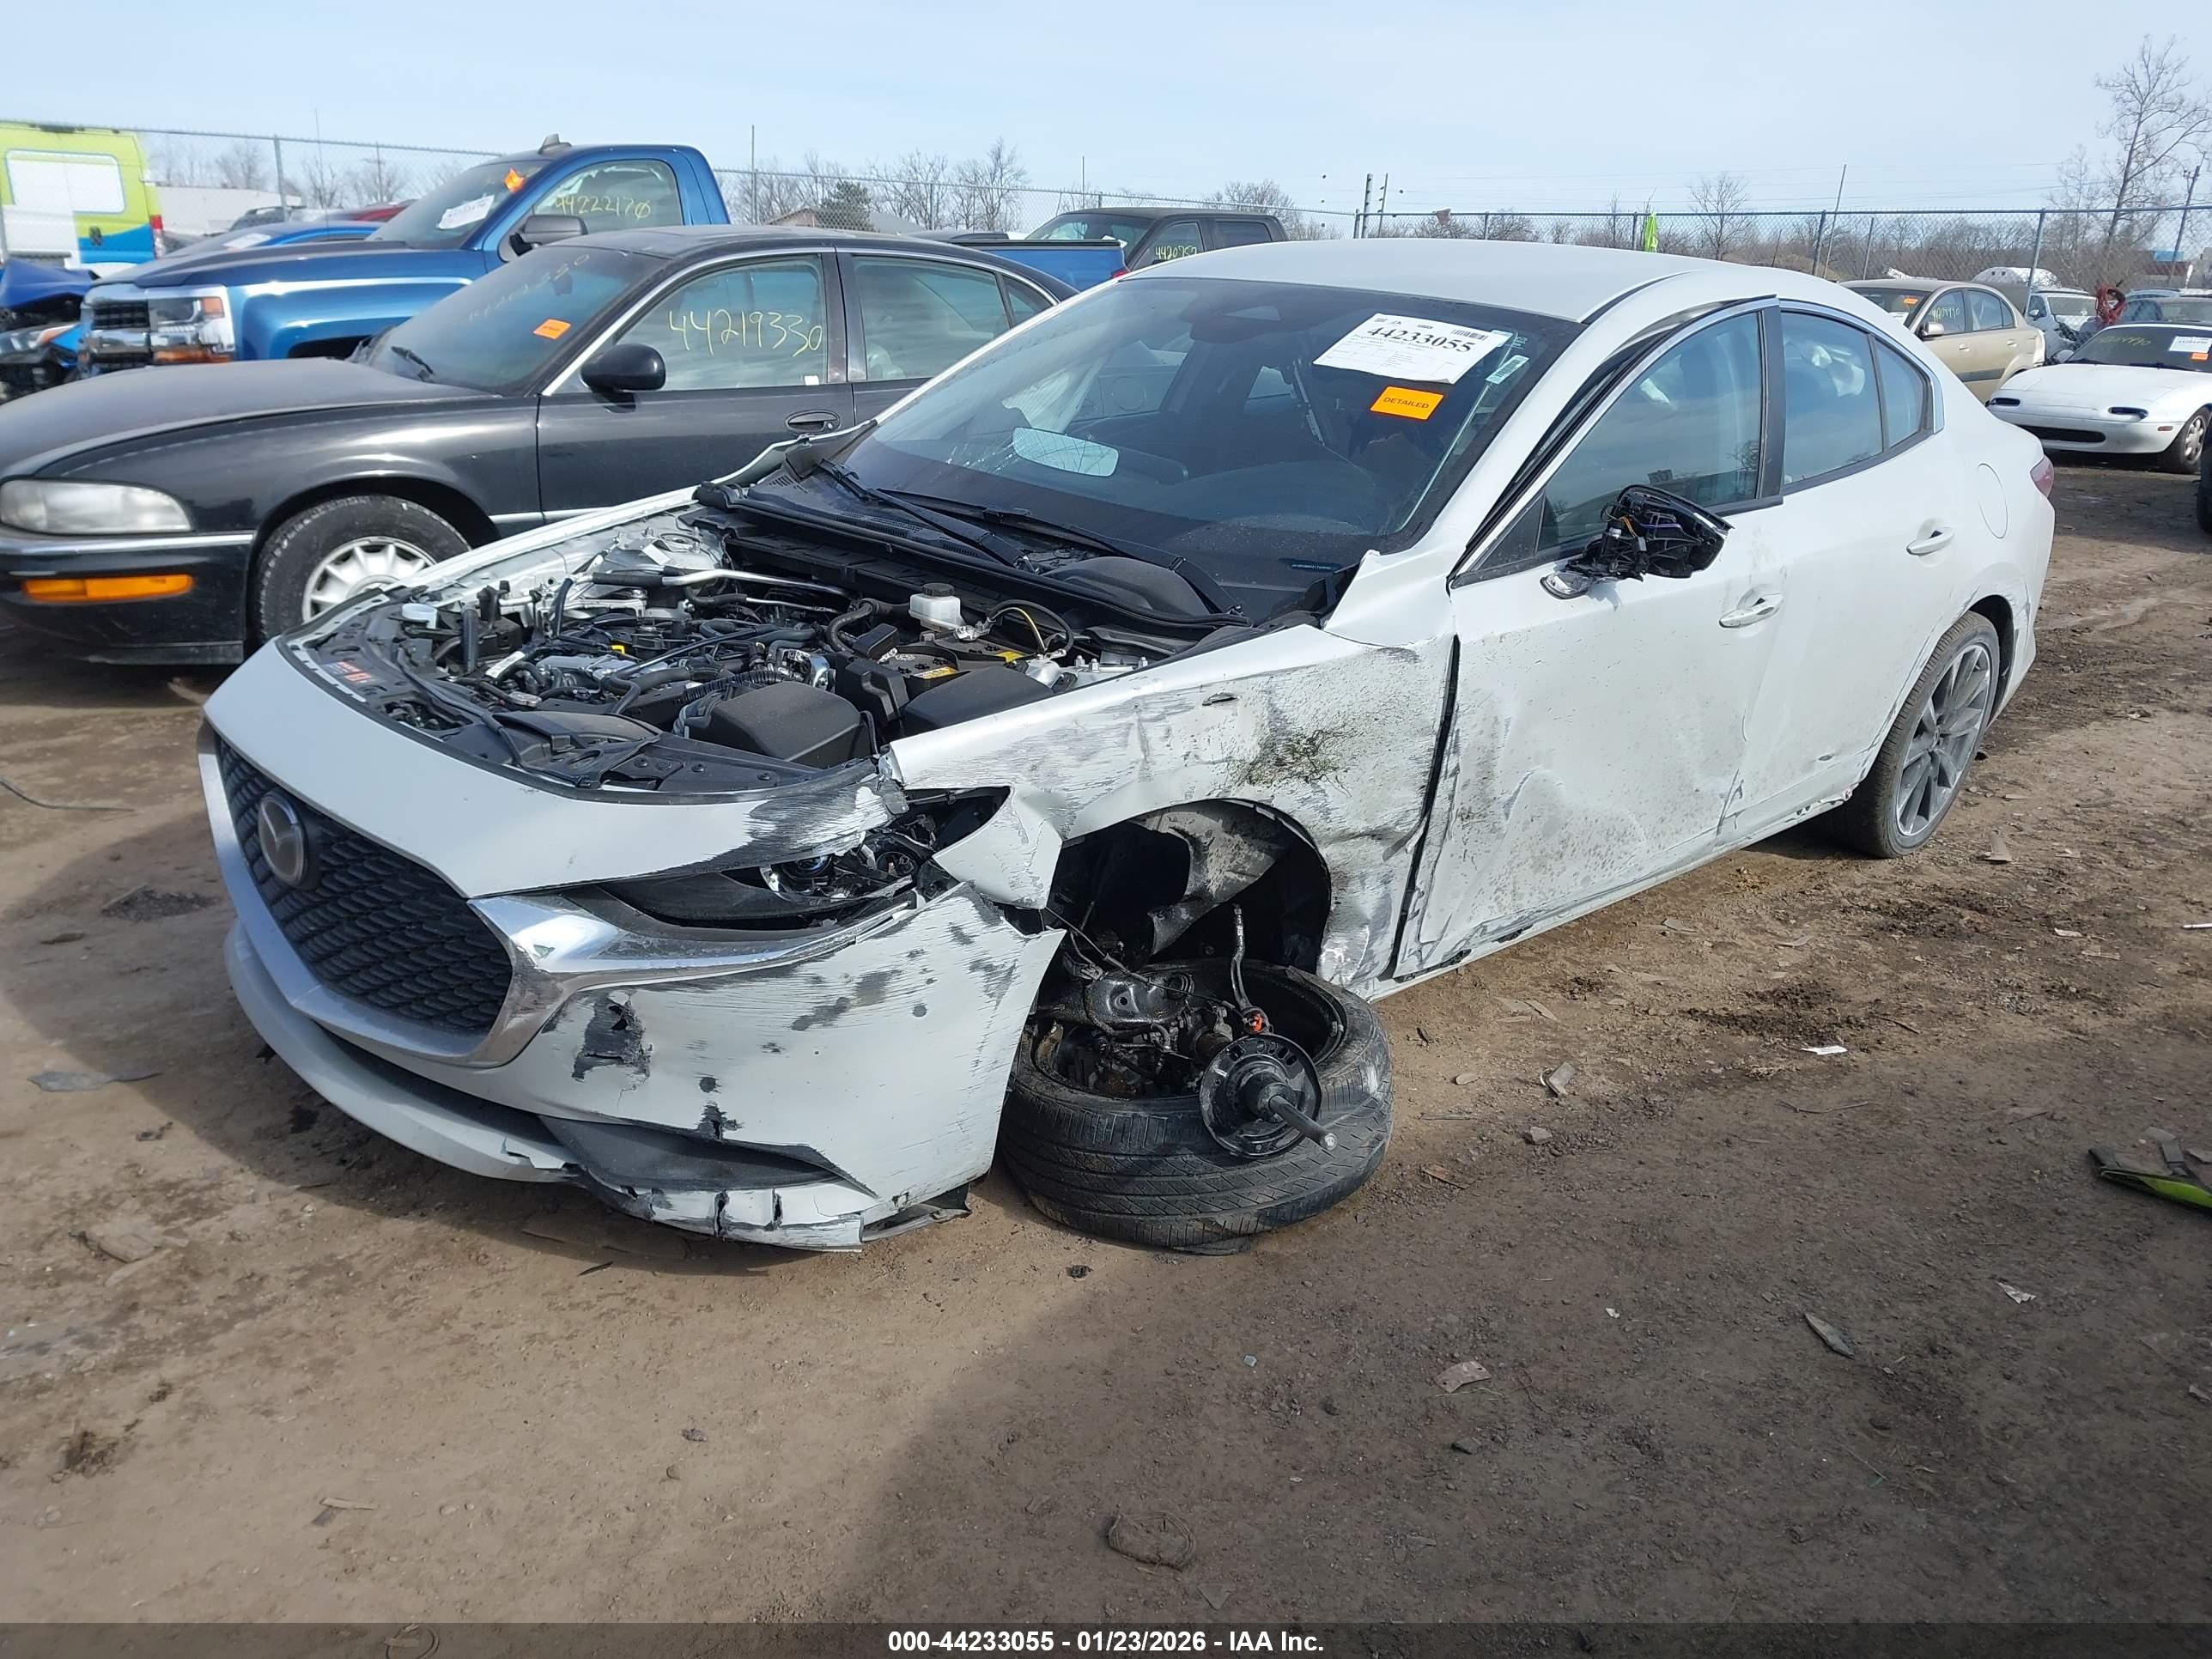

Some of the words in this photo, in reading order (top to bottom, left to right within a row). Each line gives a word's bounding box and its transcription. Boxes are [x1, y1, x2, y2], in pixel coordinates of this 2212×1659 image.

[669, 309, 823, 357] 44219330
[1367, 327, 1476, 352] 44233055
[1383, 397, 1430, 409] DETAILED
